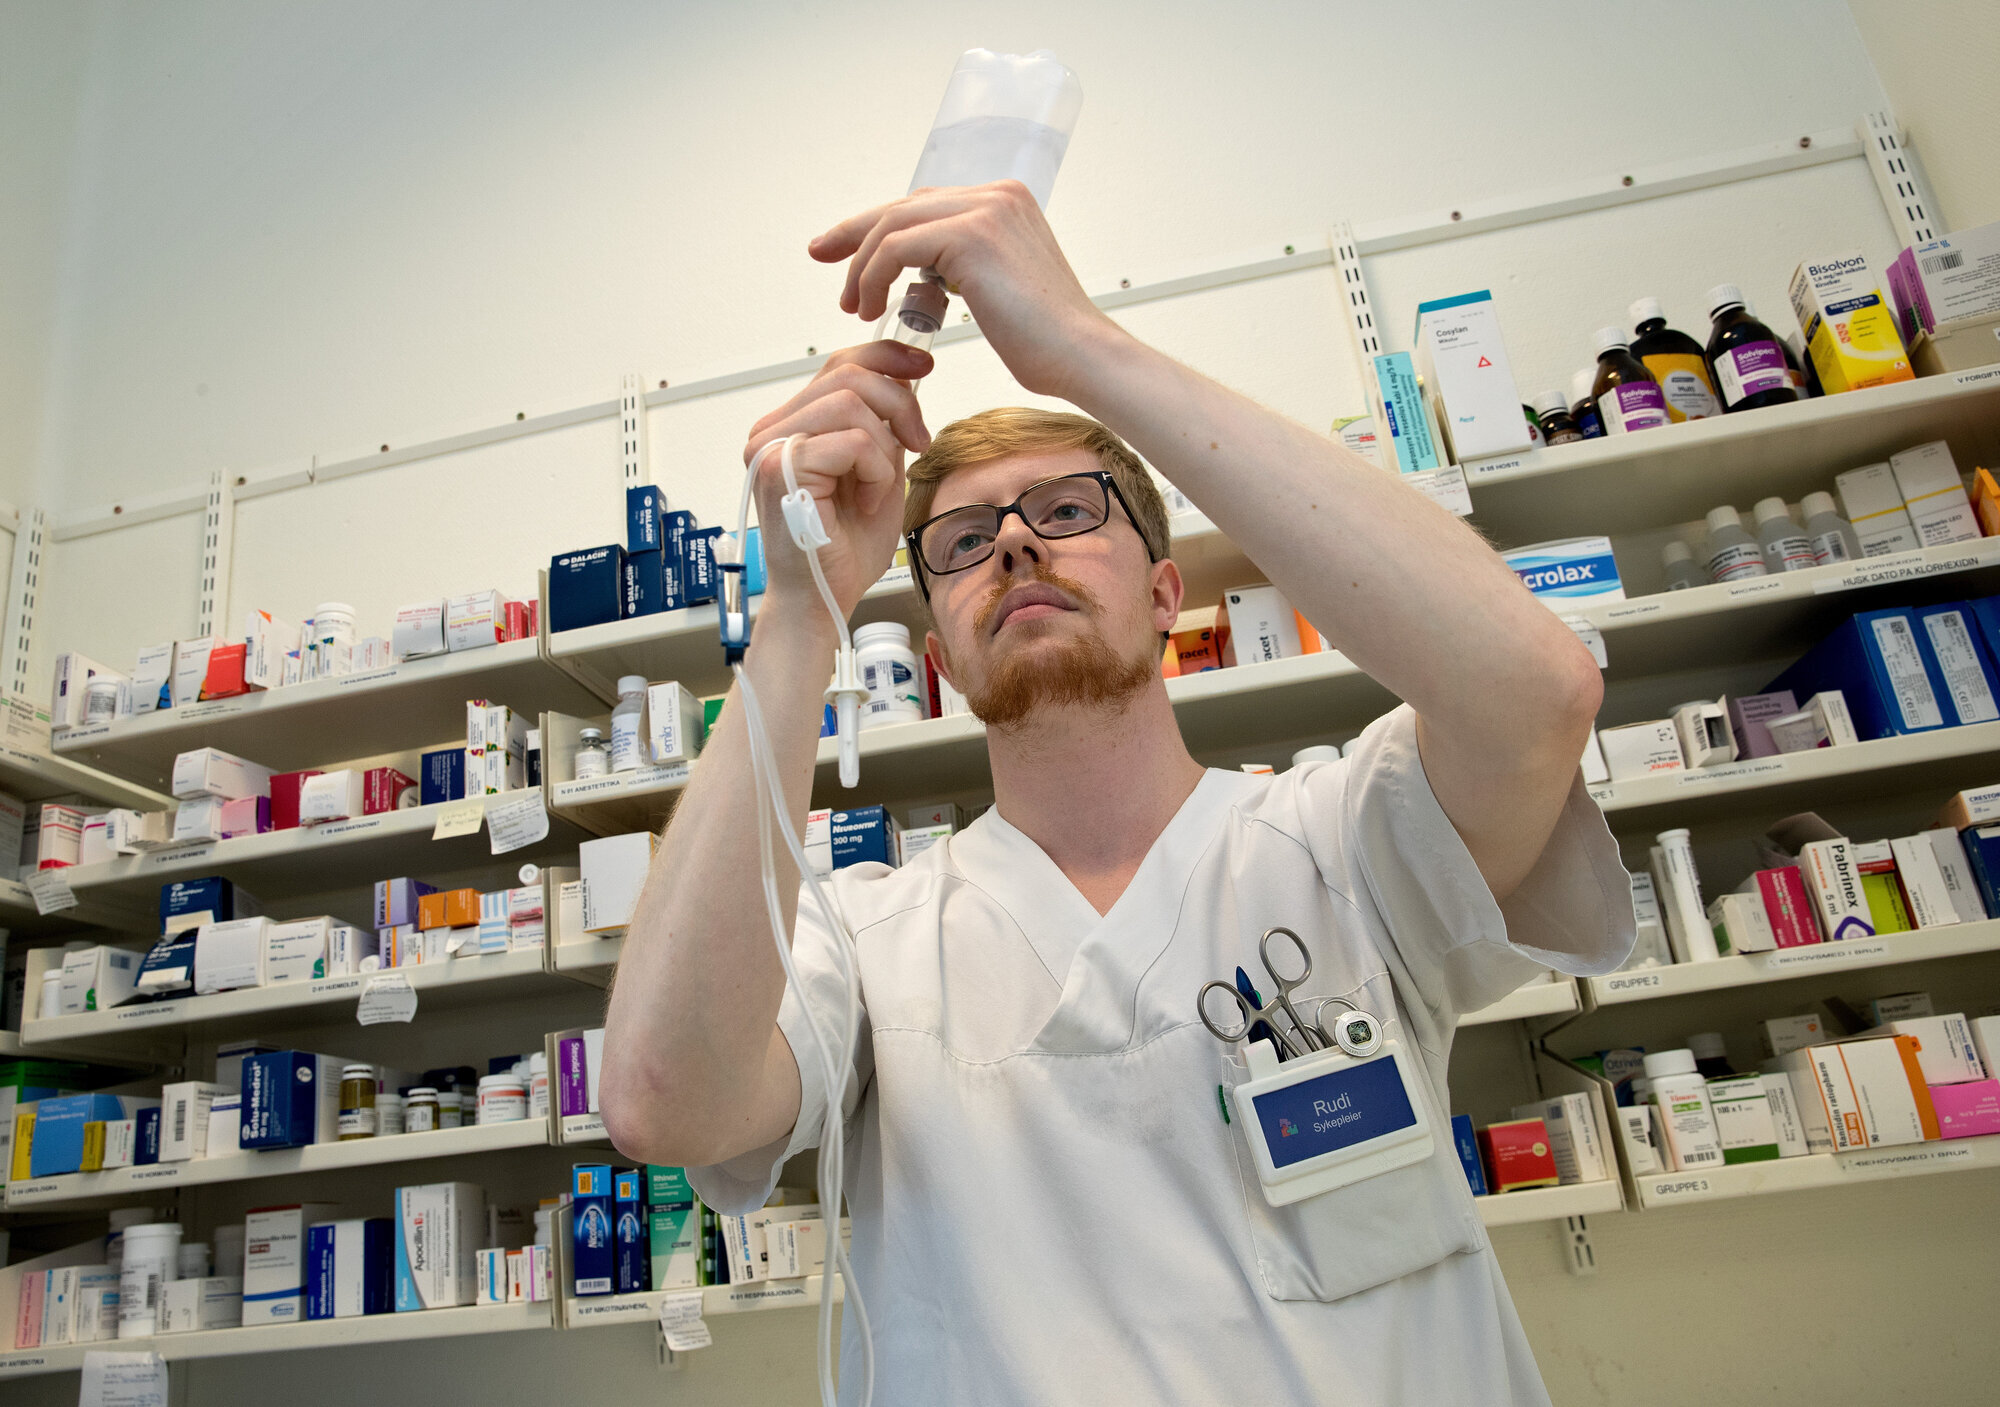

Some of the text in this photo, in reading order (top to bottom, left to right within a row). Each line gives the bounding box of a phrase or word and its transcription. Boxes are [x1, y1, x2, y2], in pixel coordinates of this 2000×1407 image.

[1808, 256, 1865, 277] Bisolvon
[1436, 326, 1468, 338] Cosylan
[1957, 376, 1963, 384] V
[1496, 461, 1520, 471] HOSTE
[1948, 515, 1962, 523] LEO
[1889, 535, 1902, 543] LEO
[570, 551, 607, 564] DALACIN
[697, 538, 707, 585] DIFLUCAN
[1517, 564, 1595, 589] icrolax
[1842, 574, 1869, 587] HUSK
[1871, 569, 1898, 584] DATO
[1915, 557, 1979, 576] KLORHEXIDIN
[1180, 647, 1209, 660] racet
[1260, 635, 1272, 661] acet
[659, 726, 673, 753] emla
[1609, 790, 1614, 798] 1
[833, 834, 863, 845] 300 mg
[1831, 844, 1858, 908] Pabrinex
[1827, 903, 1838, 915] ml
[1854, 946, 1885, 957] BRUK
[1609, 976, 1659, 990] GRUPPE 2
[571, 1042, 580, 1073] Stesolid
[250, 1065, 261, 1138] Solu-Medrol
[1313, 1092, 1351, 1117] Rudi
[1818, 1062, 1848, 1148] Ranitidin ratiopharm
[262, 1112, 269, 1125] mg
[1313, 1111, 1362, 1133] Sykepleier
[1937, 1149, 1969, 1159] BRUK
[653, 1175, 678, 1183] Rhinox
[1656, 1180, 1708, 1194] GRUPPE 3
[588, 1210, 598, 1249] Nicotinell
[414, 1226, 423, 1271] Apocillin
